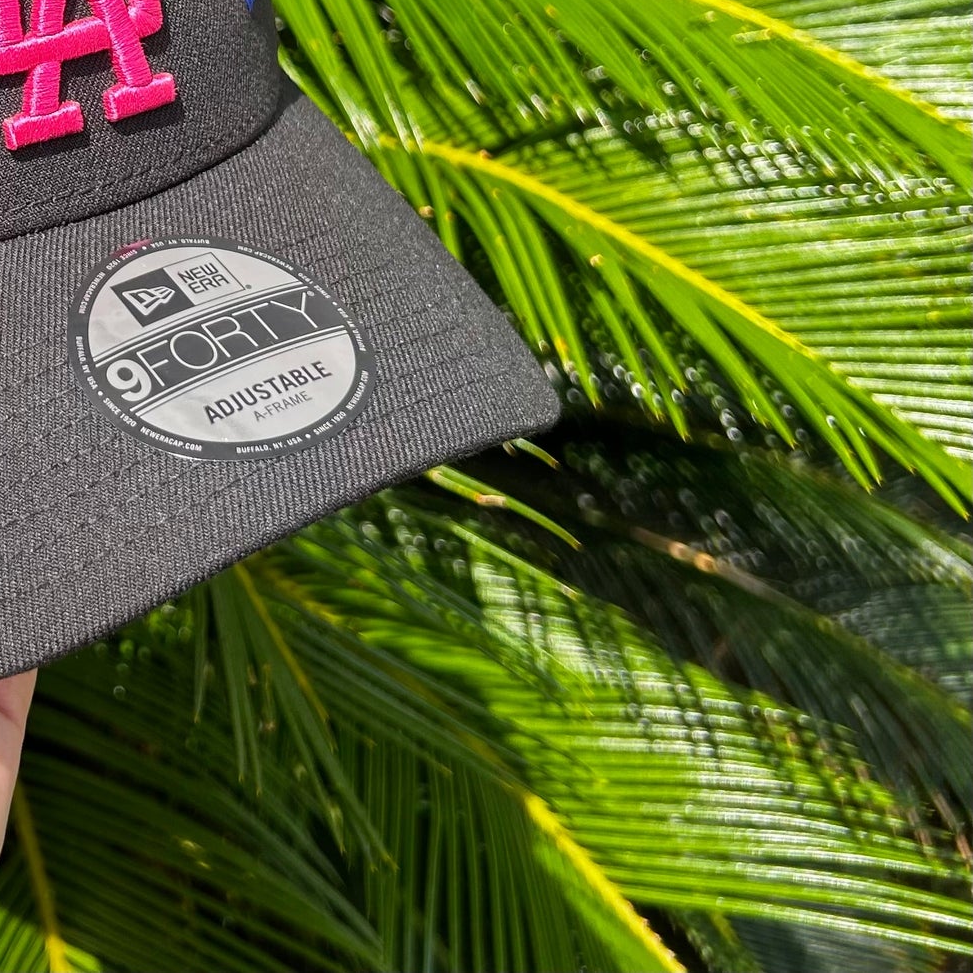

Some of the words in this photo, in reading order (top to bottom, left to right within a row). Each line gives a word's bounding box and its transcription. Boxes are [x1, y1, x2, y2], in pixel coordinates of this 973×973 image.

[177, 262, 219, 284] NEW
[187, 274, 230, 294] ERA
[106, 291, 318, 402] 9FORTY
[203, 360, 333, 425] ADJUSTABLE
[253, 390, 313, 422] A-FRAME
[86, 376, 98, 389] USA
[102, 397, 122, 416] SINCE
[119, 411, 137, 428] 1920
[140, 426, 203, 453] NEWERACAP.COM
[287, 435, 303, 447] USA
[312, 421, 333, 436] SINCE
[330, 410, 347, 426] 1920
